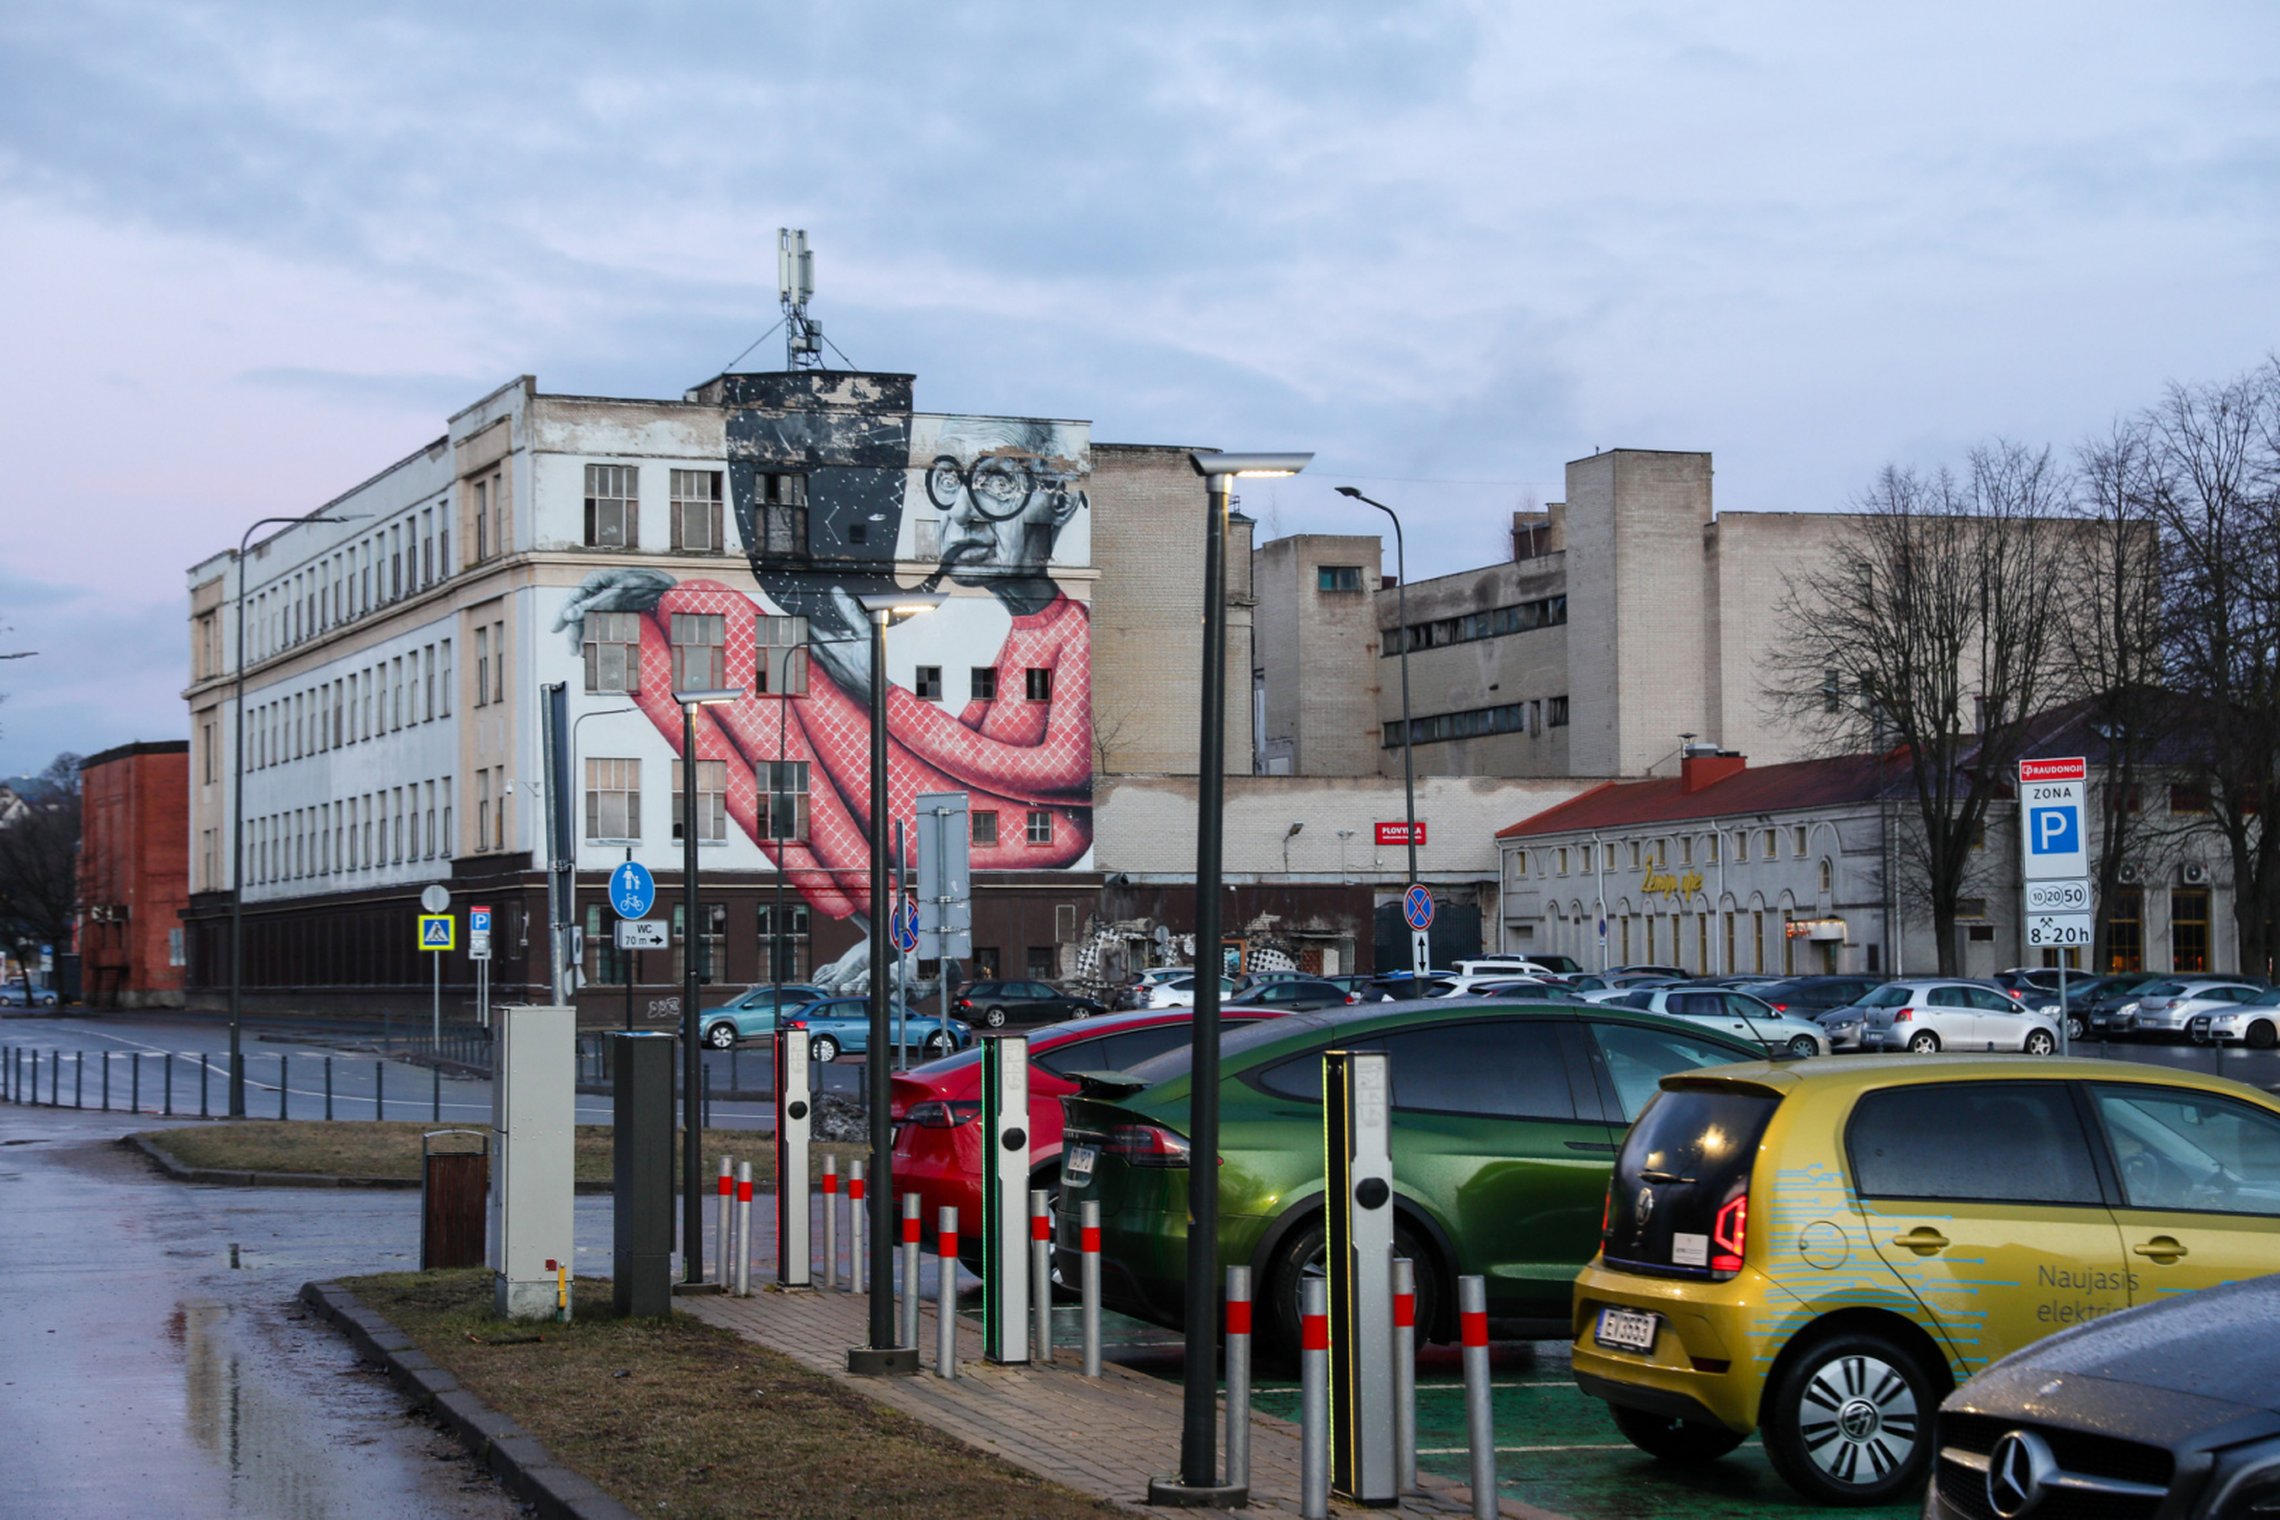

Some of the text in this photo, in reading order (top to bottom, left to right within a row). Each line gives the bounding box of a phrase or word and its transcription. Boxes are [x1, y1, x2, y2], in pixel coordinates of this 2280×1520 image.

[2033, 764, 2083, 775] RAUDONOJI
[2033, 787, 2072, 800] ZONA
[1382, 826, 1422, 834] PLOVYA
[2041, 811, 2068, 850] P
[2033, 888, 2083, 903] 10 20 50
[636, 924, 652, 934] WC
[625, 936, 647, 945] 70 m
[2038, 1264, 2140, 1295] Naujasis
